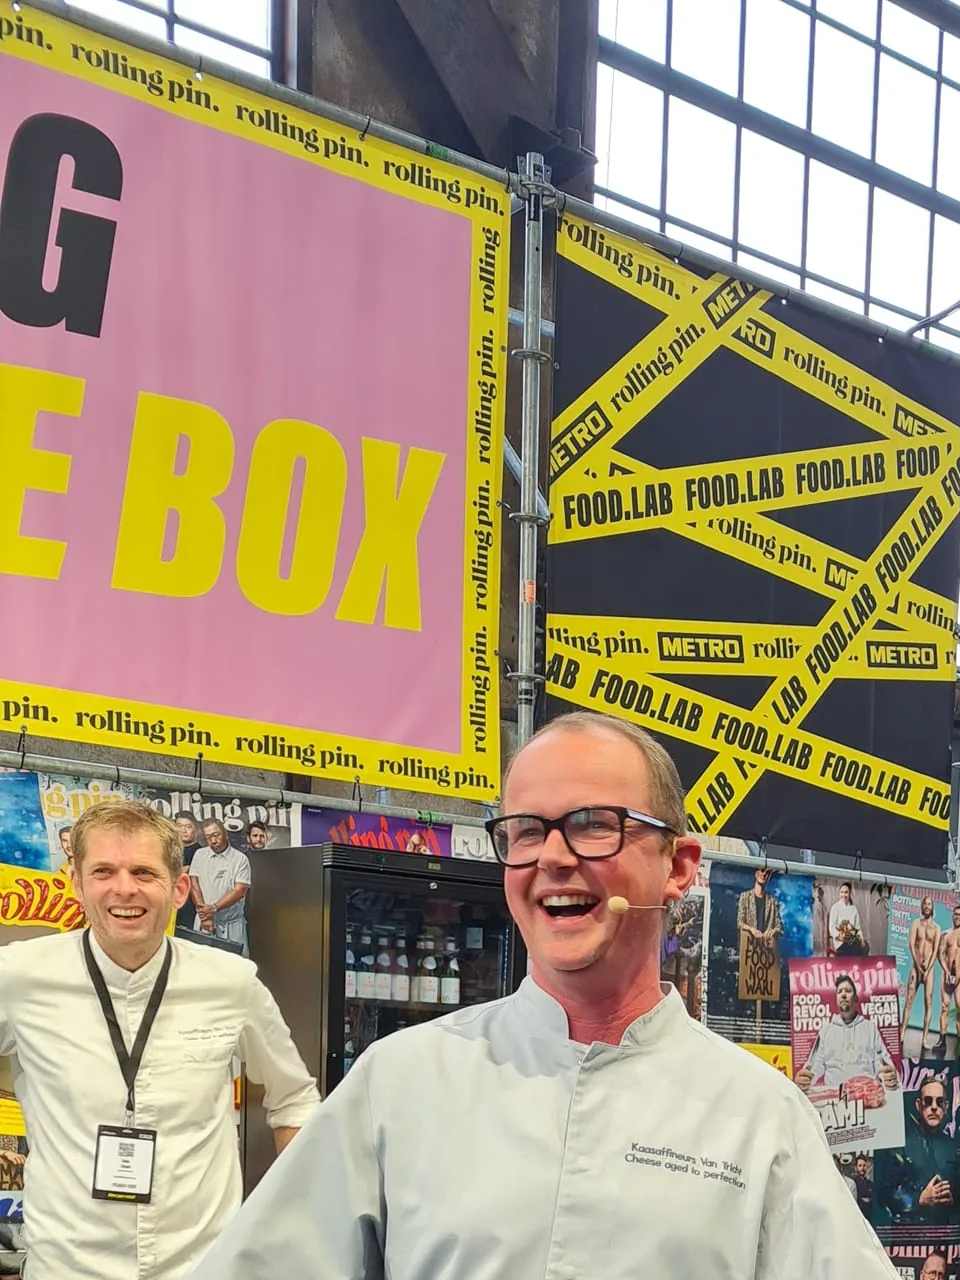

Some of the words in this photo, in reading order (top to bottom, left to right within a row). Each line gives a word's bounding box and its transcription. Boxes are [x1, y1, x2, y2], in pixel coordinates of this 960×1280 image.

[70, 42, 164, 96] rolling
[168, 79, 220, 112] pin.
[235, 103, 319, 153] rolling
[323, 130, 369, 168] pin.
[382, 158, 461, 204] rolling
[465, 186, 506, 217] pin.
[478, 227, 501, 313] rolling
[557, 215, 634, 279] rolling
[635, 265, 681, 300] pin.
[706, 279, 754, 323] MET
[476, 329, 497, 380] pin.
[610, 346, 674, 414] rolling
[668, 322, 706, 364] pin.
[783, 347, 849, 400] rolling
[849, 386, 887, 417] pin.
[474, 381, 498, 464] rolling
[111, 390, 447, 632] BOX
[472, 479, 493, 527] pin.
[562, 482, 674, 530] FOOD.LAB
[685, 466, 785, 512] FOOD.LAB
[796, 452, 886, 495] FOOD.LAB
[471, 530, 494, 611] rolling
[778, 544, 817, 574] pin.
[874, 495, 943, 594] FOOD.LAB
[470, 625, 490, 673] pin.
[604, 630, 650, 658] pin.
[661, 636, 741, 659] METRO
[804, 583, 877, 686] FOOD.LAB
[869, 644, 936, 665] METRO
[2, 696, 58, 723] pin.
[75, 710, 167, 744] rolling
[170, 722, 220, 748] pin.
[234, 733, 317, 770] rolling
[319, 740, 365, 770] pin.
[377, 755, 451, 789] rolling
[454, 763, 496, 789] pin.
[469, 675, 492, 754] rolling
[589, 668, 704, 732] FOOD.LAB
[711, 712, 813, 771] FOOD.LAB
[819, 751, 912, 806] FOOD.LAB
[745, 949, 776, 969] FOOD
[862, 960, 898, 996] pin
[792, 994, 821, 1006] FOOD
[792, 1004, 832, 1018] REVOL
[861, 1002, 898, 1016] VEGAN
[624, 1153, 662, 1168] Cheese
[664, 1161, 689, 1174] aged
[691, 1166, 701, 1177] to
[703, 1171, 747, 1191] perfection
[631, 1142, 697, 1165] Kaasaffineurs
[700, 1156, 718, 1169] Van
